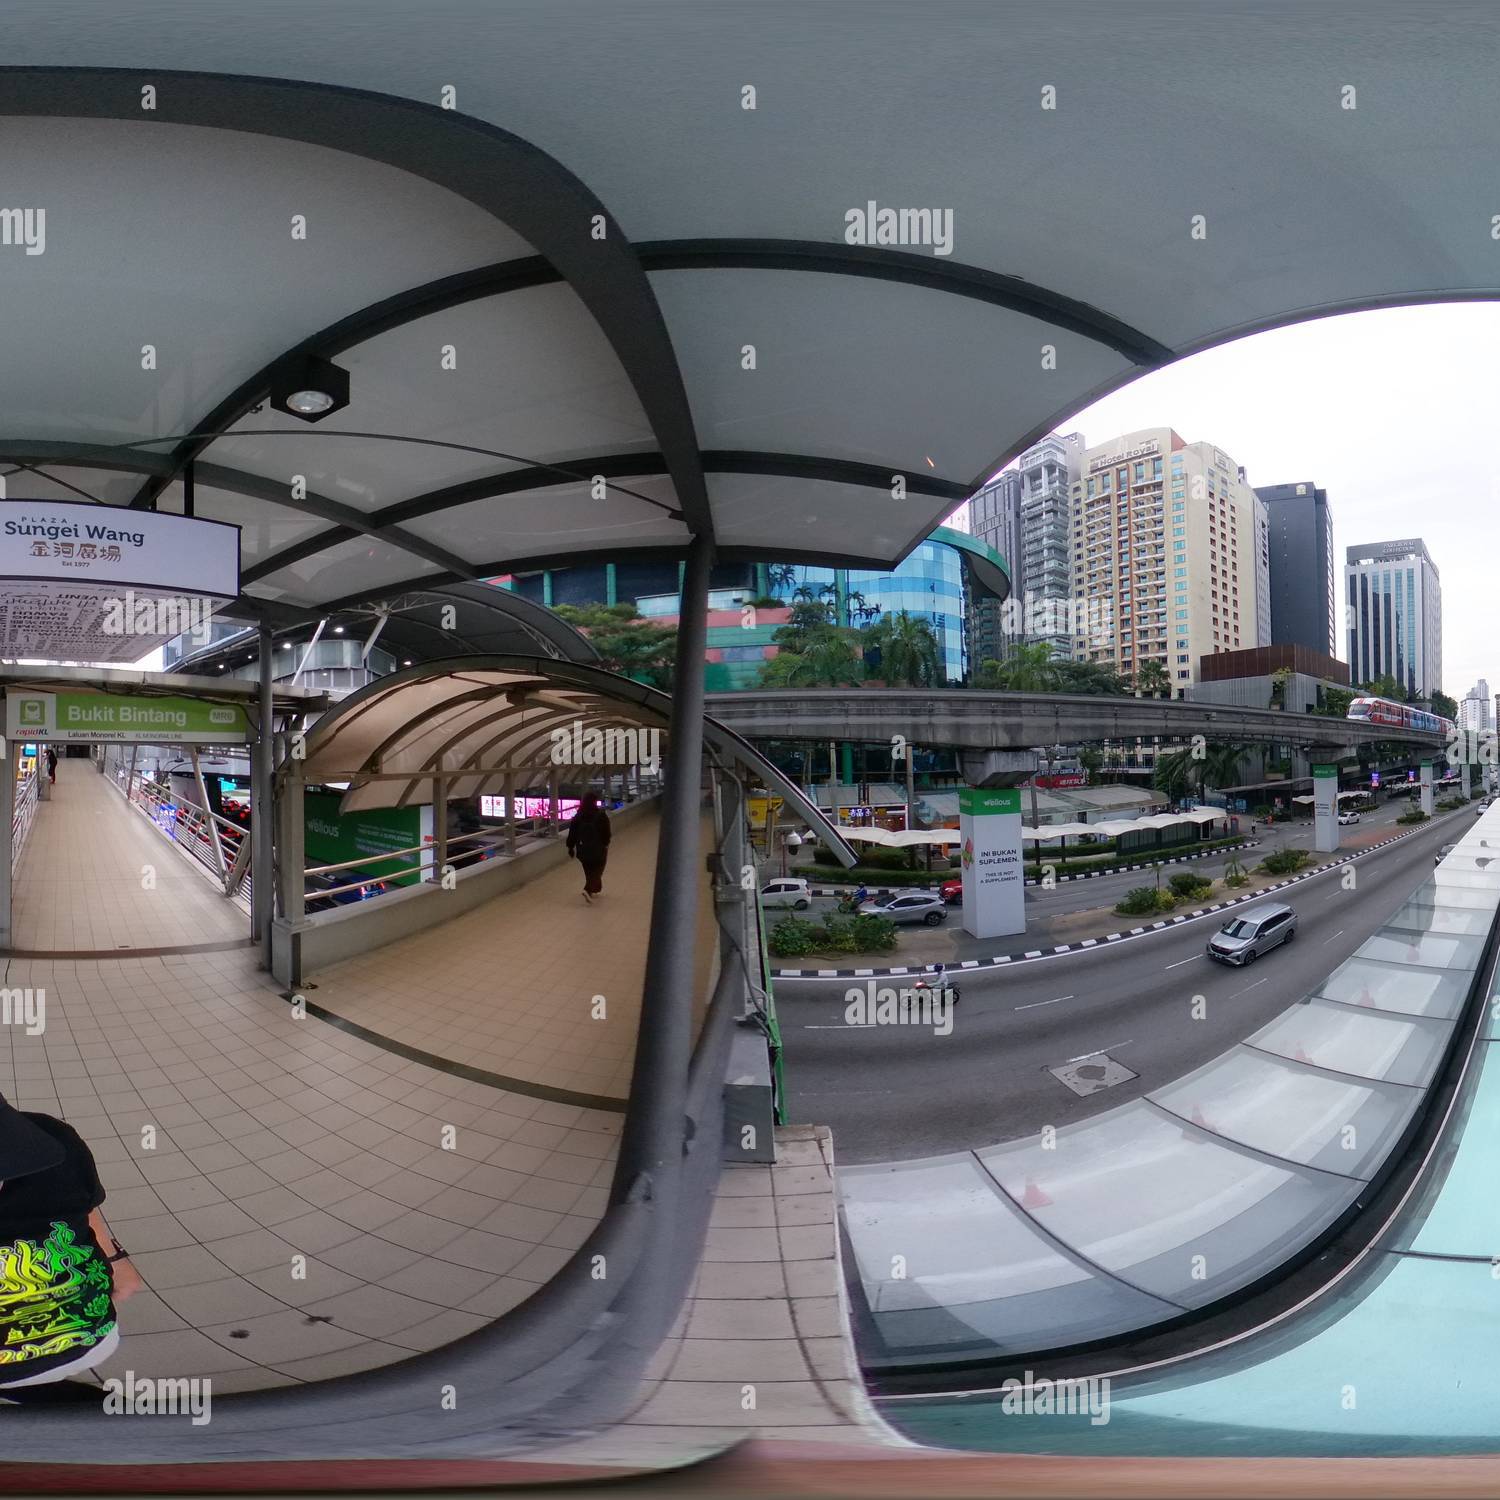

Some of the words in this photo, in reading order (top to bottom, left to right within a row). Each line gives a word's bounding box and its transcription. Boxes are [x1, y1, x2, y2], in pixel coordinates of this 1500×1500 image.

[21, 516, 68, 524] PLAZA
[4, 521, 80, 540] Sungei
[85, 524, 145, 547] Wang
[68, 705, 114, 721] Bukit
[119, 706, 187, 727] Bintang
[992, 849, 1017, 857] BUKAN
